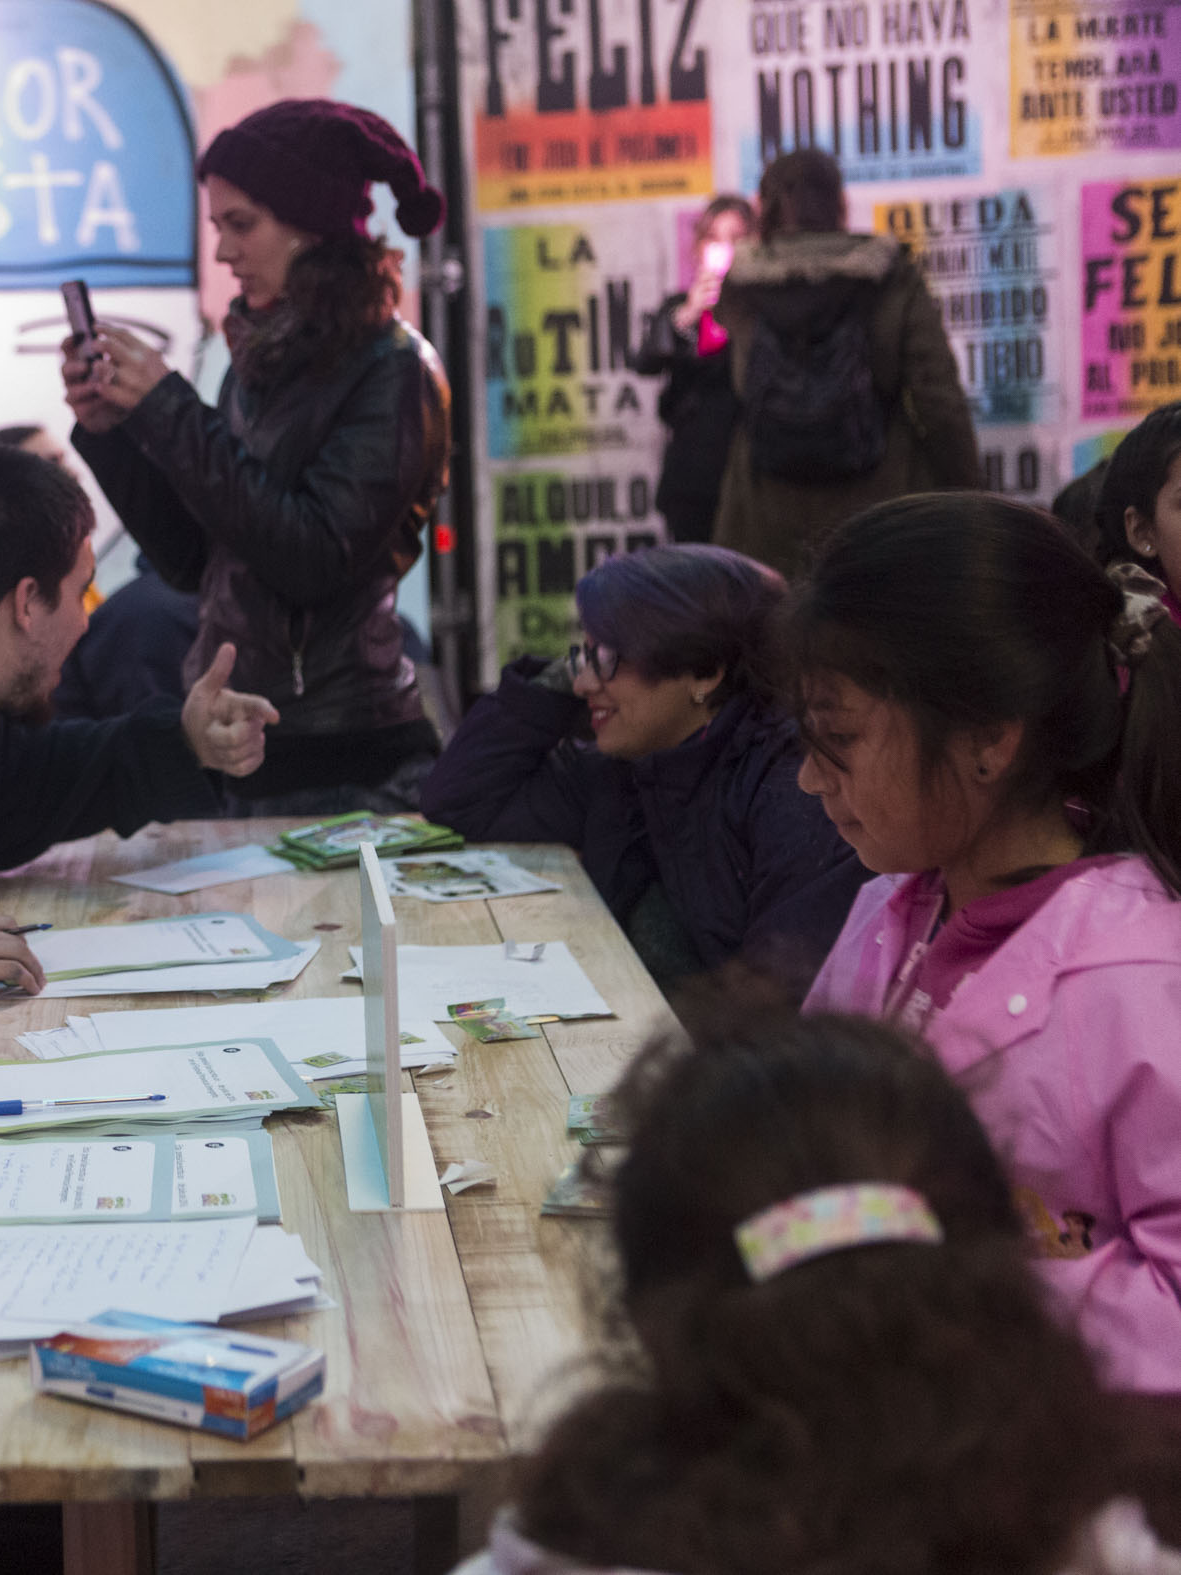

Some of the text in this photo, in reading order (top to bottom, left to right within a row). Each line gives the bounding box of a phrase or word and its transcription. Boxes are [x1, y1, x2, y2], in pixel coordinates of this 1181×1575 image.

[753, 0, 969, 54] QUE NO HAYA
[1027, 20, 1058, 43] LA
[485, 0, 707, 119] FELIZ
[757, 56, 967, 160] NOTHING
[887, 192, 1035, 237] QUEDA
[536, 233, 594, 270] LA
[503, 383, 641, 418] MATA
